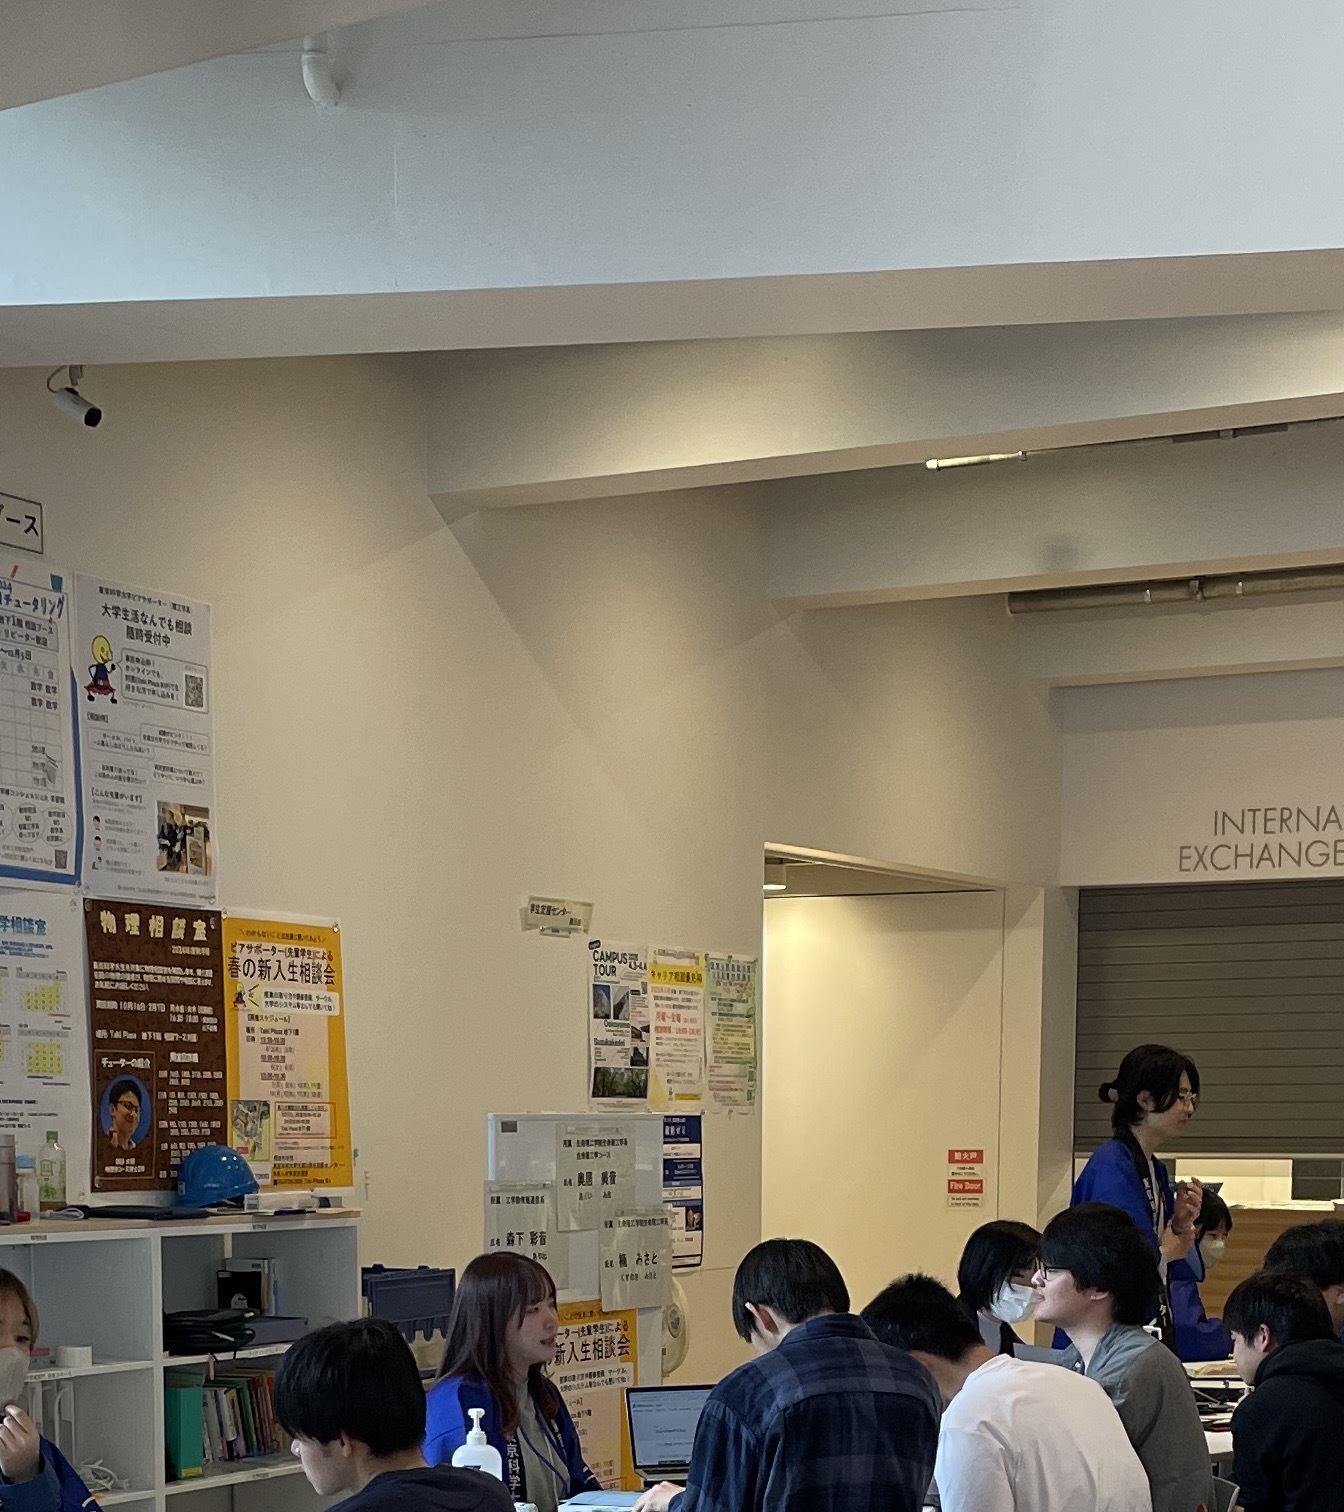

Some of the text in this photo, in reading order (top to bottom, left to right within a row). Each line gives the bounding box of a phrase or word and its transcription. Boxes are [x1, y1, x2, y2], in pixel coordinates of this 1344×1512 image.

[593, 950, 628, 964] CAMPUS
[228, 956, 335, 985] 春の新入生相談会
[593, 963, 616, 977] TOUR
[950, 1181, 964, 1190] Fire
